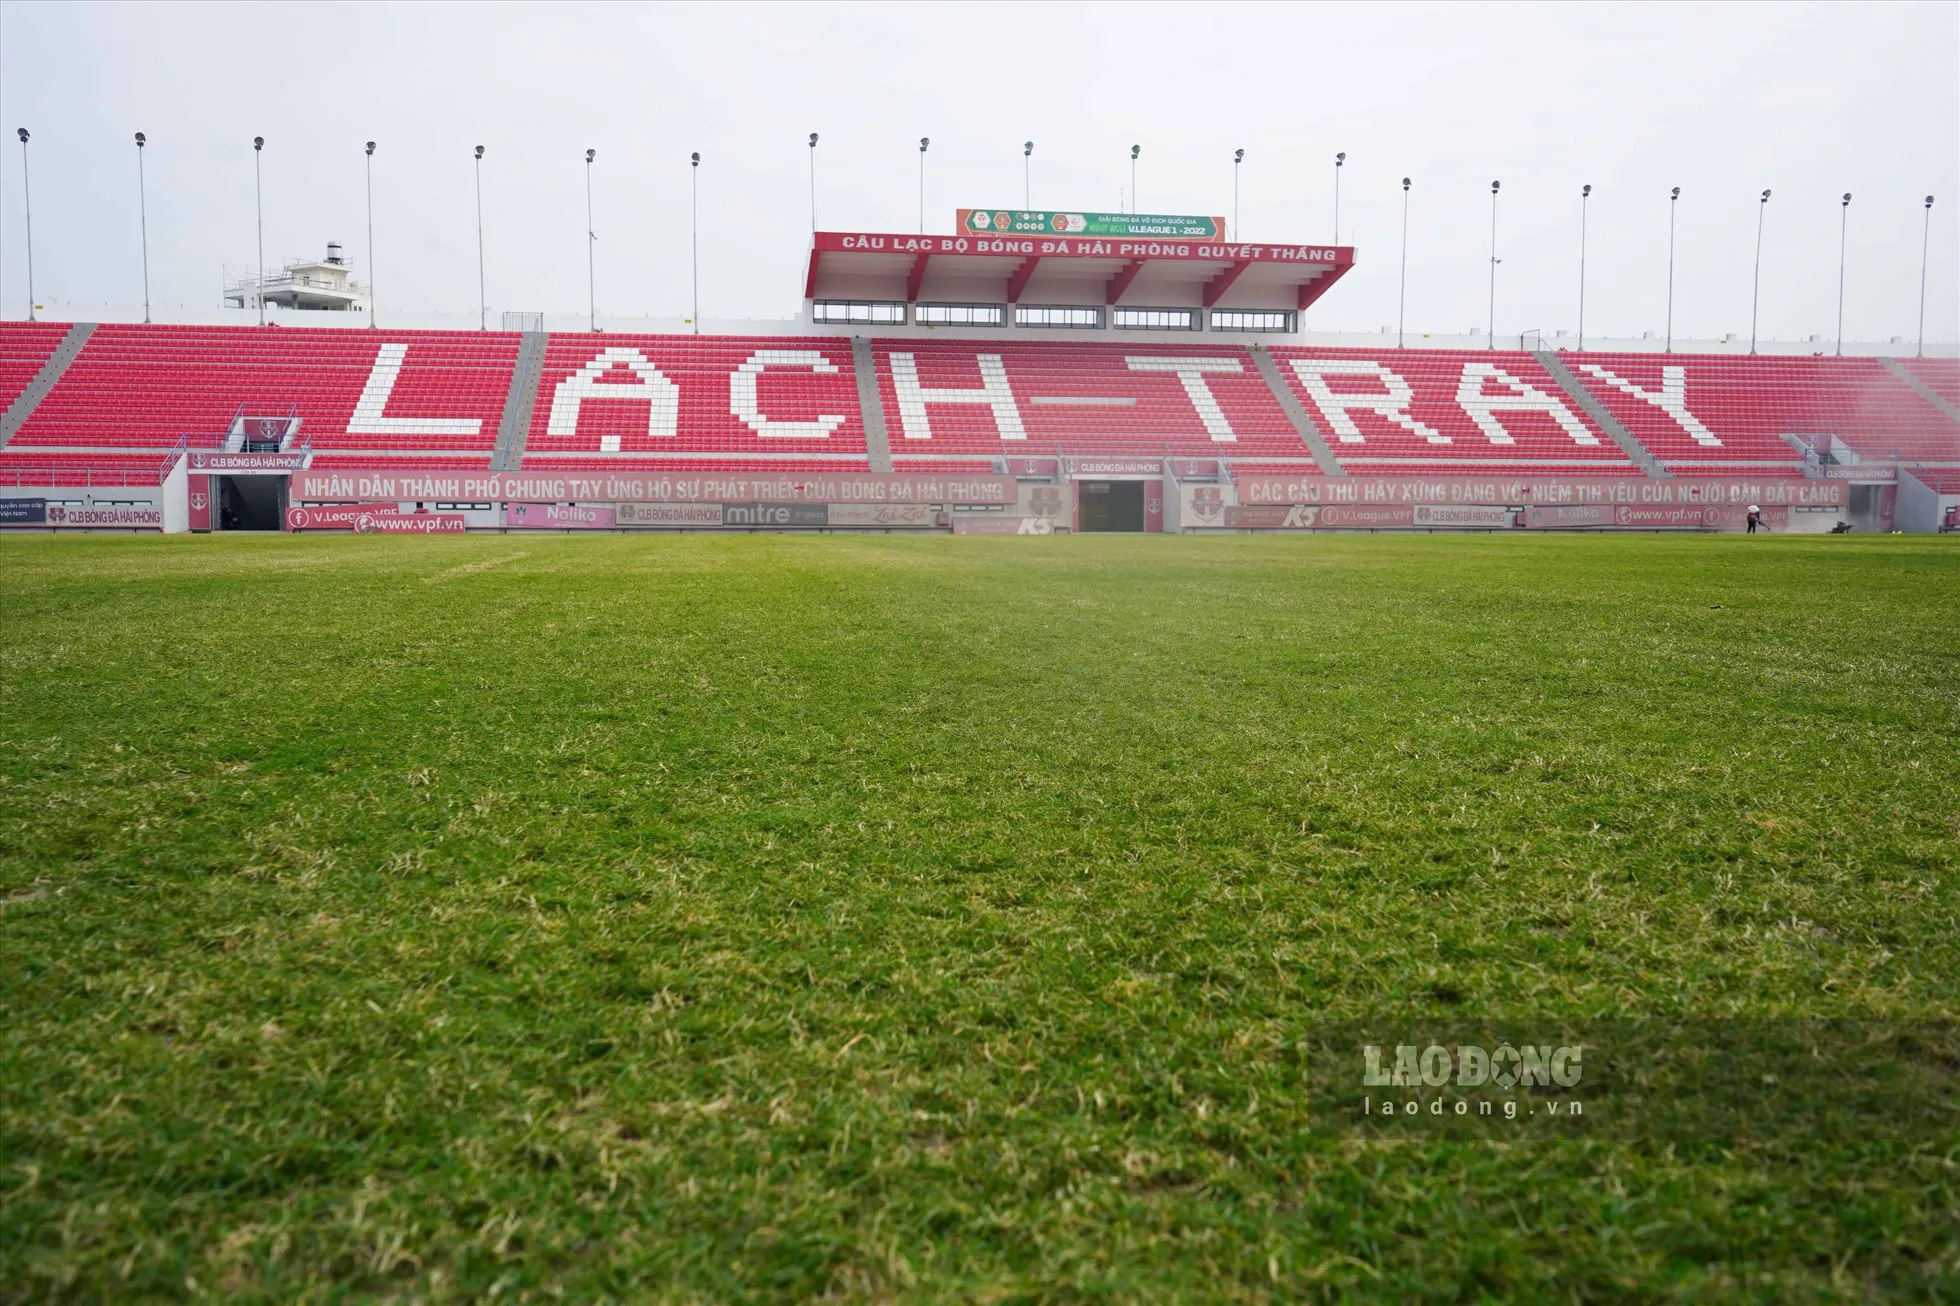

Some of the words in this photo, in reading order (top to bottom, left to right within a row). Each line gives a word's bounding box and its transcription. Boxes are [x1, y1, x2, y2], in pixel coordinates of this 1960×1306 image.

[1128, 225, 1171, 234] V.LEAGUE
[1172, 226, 1178, 234] 1
[1183, 227, 1206, 235] 2022
[842, 235, 884, 249] CÂU
[893, 238, 932, 252] LẠC
[941, 238, 968, 253] BỘ
[977, 239, 1033, 253] BÓNG
[1041, 240, 1069, 254] ĐÁ
[1078, 240, 1112, 254] HẢI
[1120, 242, 1189, 256] PHÒNG
[1198, 244, 1263, 258] QUYẾT
[1270, 245, 1336, 260] THẮNG
[211, 457, 226, 467] CLB
[227, 456, 249, 467] BÓNG
[250, 456, 262, 467] ĐÁ
[263, 456, 275, 467] HẢI
[1081, 463, 1095, 472] CLB
[1095, 461, 1115, 472] BÓNG
[304, 474, 354, 497] NHÂN
[359, 475, 395, 497] DÂN
[400, 475, 459, 497] THÀNH
[464, 474, 501, 498] PHỐ
[505, 479, 565, 498] CHUNG
[568, 480, 602, 498] TAY
[607, 475, 643, 498] ỦNG
[649, 477, 671, 501] HỘ
[676, 478, 700, 502] SỰ
[704, 477, 747, 498] PHÁT
[804, 476, 836, 499] CỦA
[841, 477, 885, 499] BÓNG
[890, 477, 912, 499] ĐÁ
[917, 477, 943, 499] HẢI
[950, 478, 1004, 500] PHÒNG
[1250, 479, 1282, 501] CÁC
[1326, 479, 1359, 501] THỦ
[1364, 480, 1397, 501] HÃY
[1402, 479, 1446, 501] XỨNG
[1451, 480, 1499, 501] ĐÁNG
[1576, 485, 1601, 502] TIN
[1608, 481, 1637, 502] YÊU
[1642, 480, 1673, 502] CỦA
[1730, 481, 1761, 502] DÂN
[1765, 480, 1798, 502] ĐẤT
[1800, 480, 1840, 502] CẢNG
[69, 511, 84, 523] CLB
[85, 508, 107, 523] BÓNG
[108, 508, 119, 523] ĐÁ
[120, 508, 132, 523] HẢI
[134, 508, 160, 523] PHÒNG
[638, 509, 651, 520] CLB
[653, 506, 672, 520] BÓNG
[697, 506, 720, 520] PHÒNG
[727, 503, 790, 523] mitre
[1282, 506, 1320, 527] K5
[1343, 510, 1412, 523] V.League.VPF
[1632, 508, 1701, 521] www.vpf.vn
[374, 517, 463, 533] www.vpf.vn
[1017, 518, 1051, 535] K5
